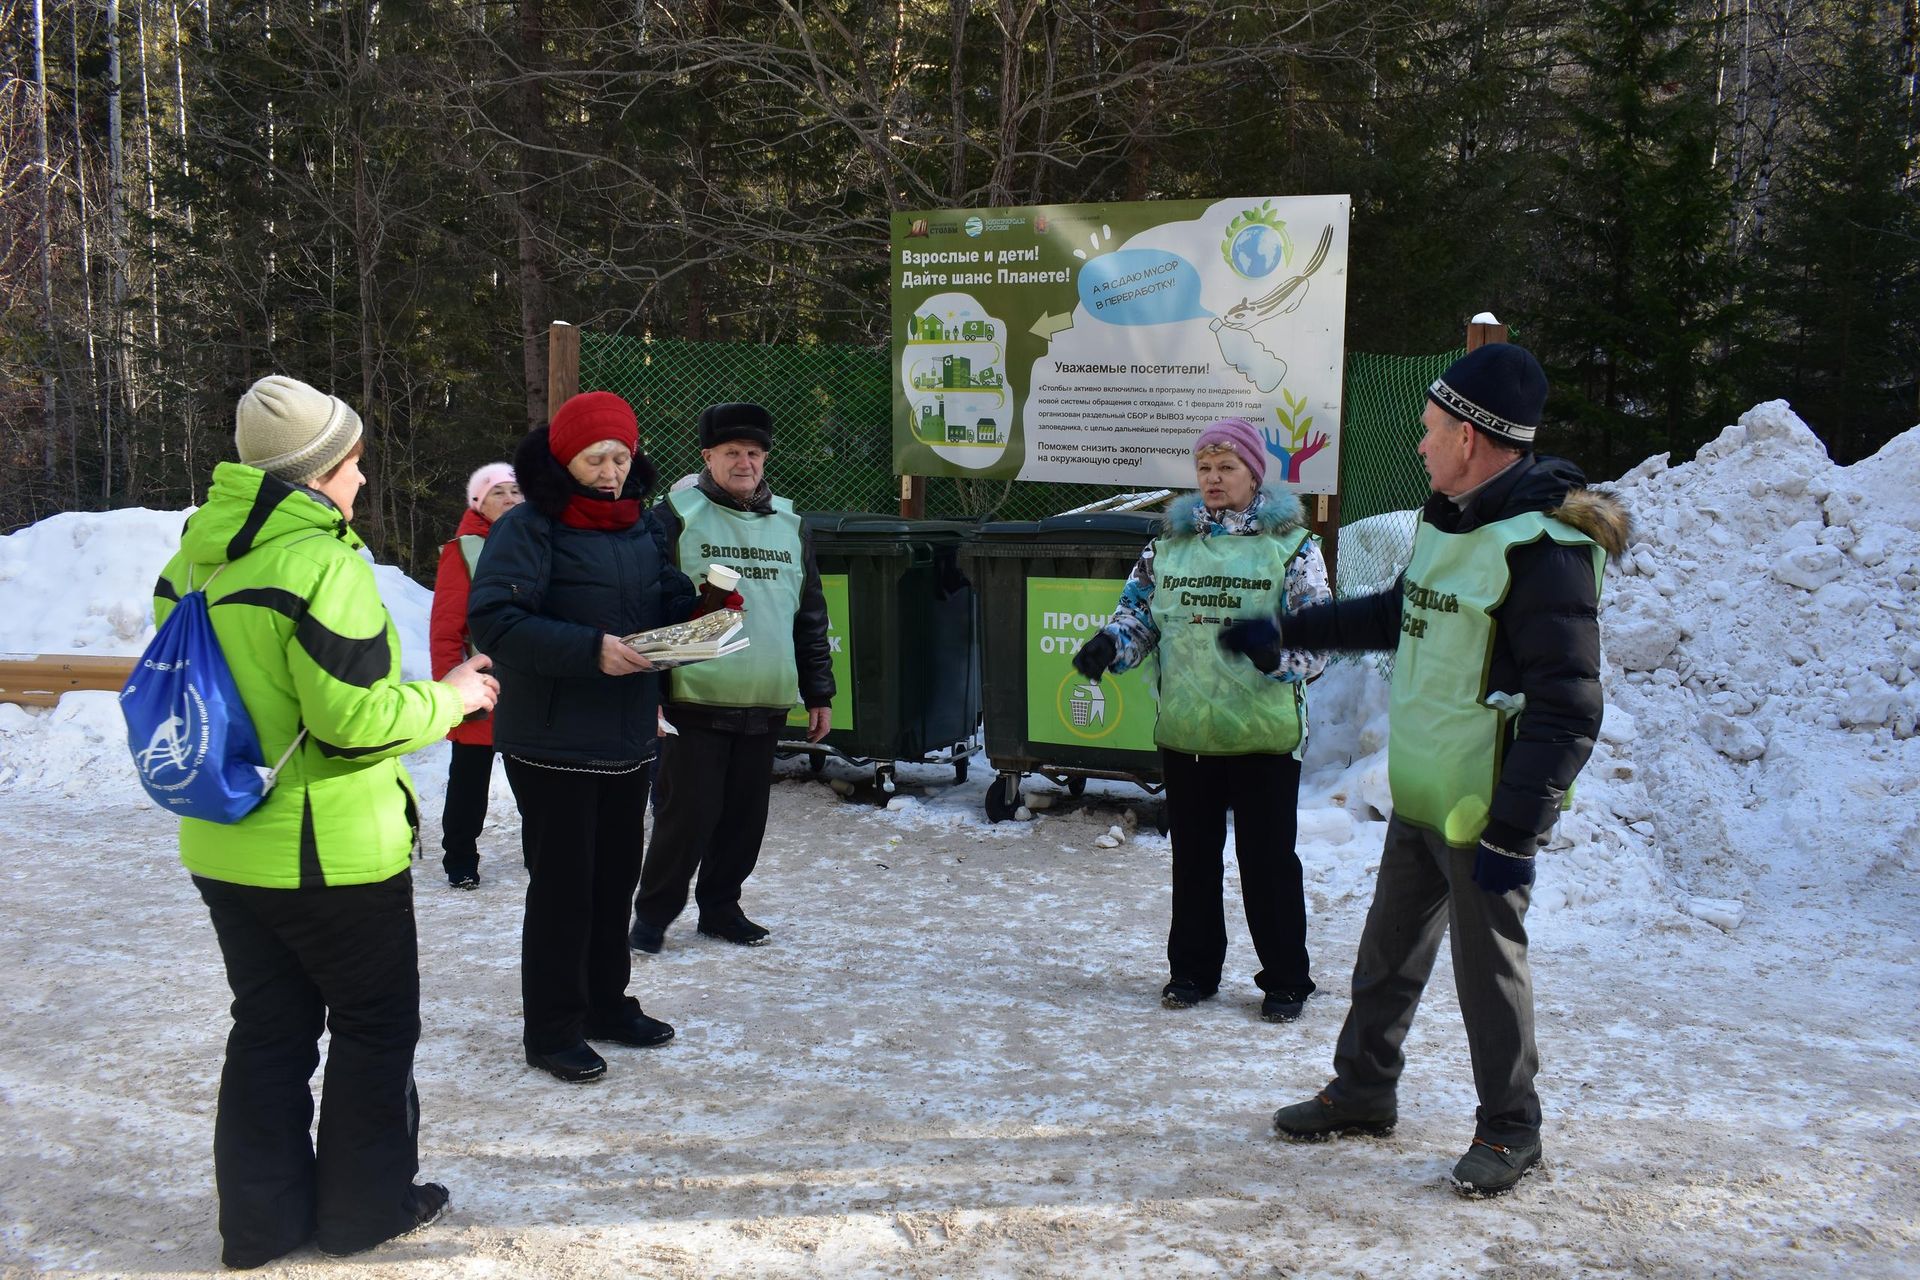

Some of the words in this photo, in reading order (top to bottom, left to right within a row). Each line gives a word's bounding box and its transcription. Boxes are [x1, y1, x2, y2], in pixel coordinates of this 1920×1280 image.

[902, 250, 979, 267] Взрослые
[984, 251, 993, 262] и
[998, 245, 1039, 264] дети!
[901, 271, 947, 288] Дайте
[951, 271, 992, 285] шанс
[998, 267, 1070, 284] Планете!
[1093, 285, 1100, 294] А
[1102, 282, 1110, 291] Я
[1111, 272, 1142, 289] СДАЮ
[1095, 301, 1104, 310] В
[1104, 278, 1175, 307] ПЕРЕРАБОТКУ!
[1054, 361, 1127, 374] Уважаемые
[1131, 362, 1210, 374] посетители!
[1155, 387, 1195, 395] программу
[1092, 398, 1132, 406] обращения
[1190, 400, 1224, 408] февраля
[1082, 411, 1125, 419] раздельный
[1038, 424, 1082, 432] заповедника,
[1037, 441, 1079, 451] Поможем
[1081, 444, 1117, 453] снизить
[1119, 446, 1190, 456] экологическую
[1050, 455, 1110, 465] окружающую
[1112, 456, 1143, 467] среду!
[700, 543, 793, 564] Заповедный
[1162, 575, 1272, 591] Красноярские
[1180, 591, 1242, 608] Столбы
